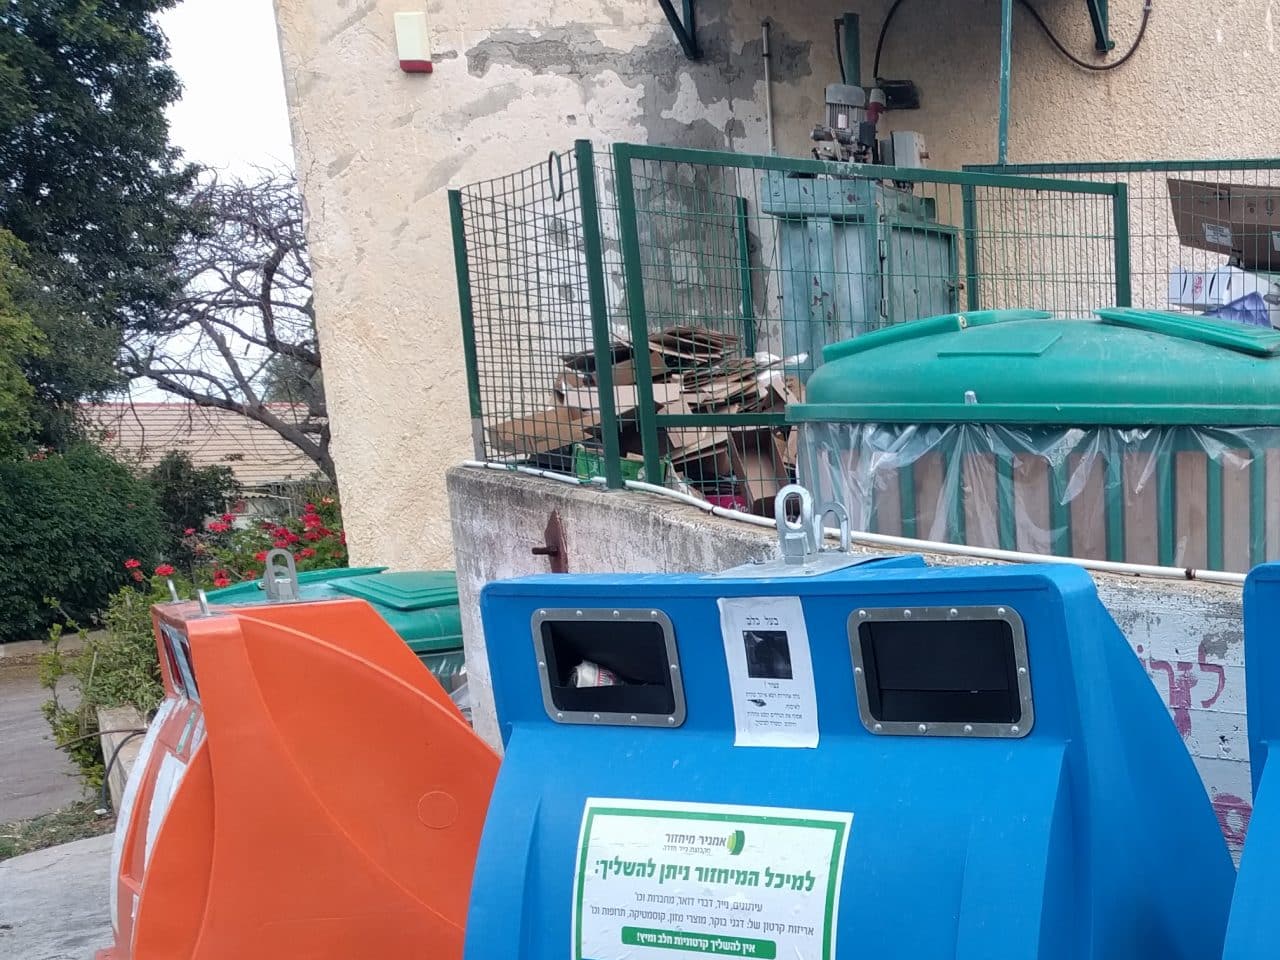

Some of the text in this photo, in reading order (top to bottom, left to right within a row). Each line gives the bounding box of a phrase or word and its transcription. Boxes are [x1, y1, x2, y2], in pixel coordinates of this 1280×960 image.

[699, 835, 727, 847] אמניר
[595, 855, 816, 891] למיכל המיחזור ניתן להשליך:
[647, 894, 675, 904] מחברות
[697, 898, 713, 908] דברי
[602, 906, 626, 917] תרופות
[686, 914, 707, 925] מוצרי
[730, 918, 744, 928] דגני
[763, 921, 785, 935] קרטון
[788, 924, 814, 936] אריזות
[658, 933, 673, 944] חלב
[674, 936, 709, 950] קרטוניות
[711, 938, 740, 951] להשליך
[742, 943, 755, 955] אין
